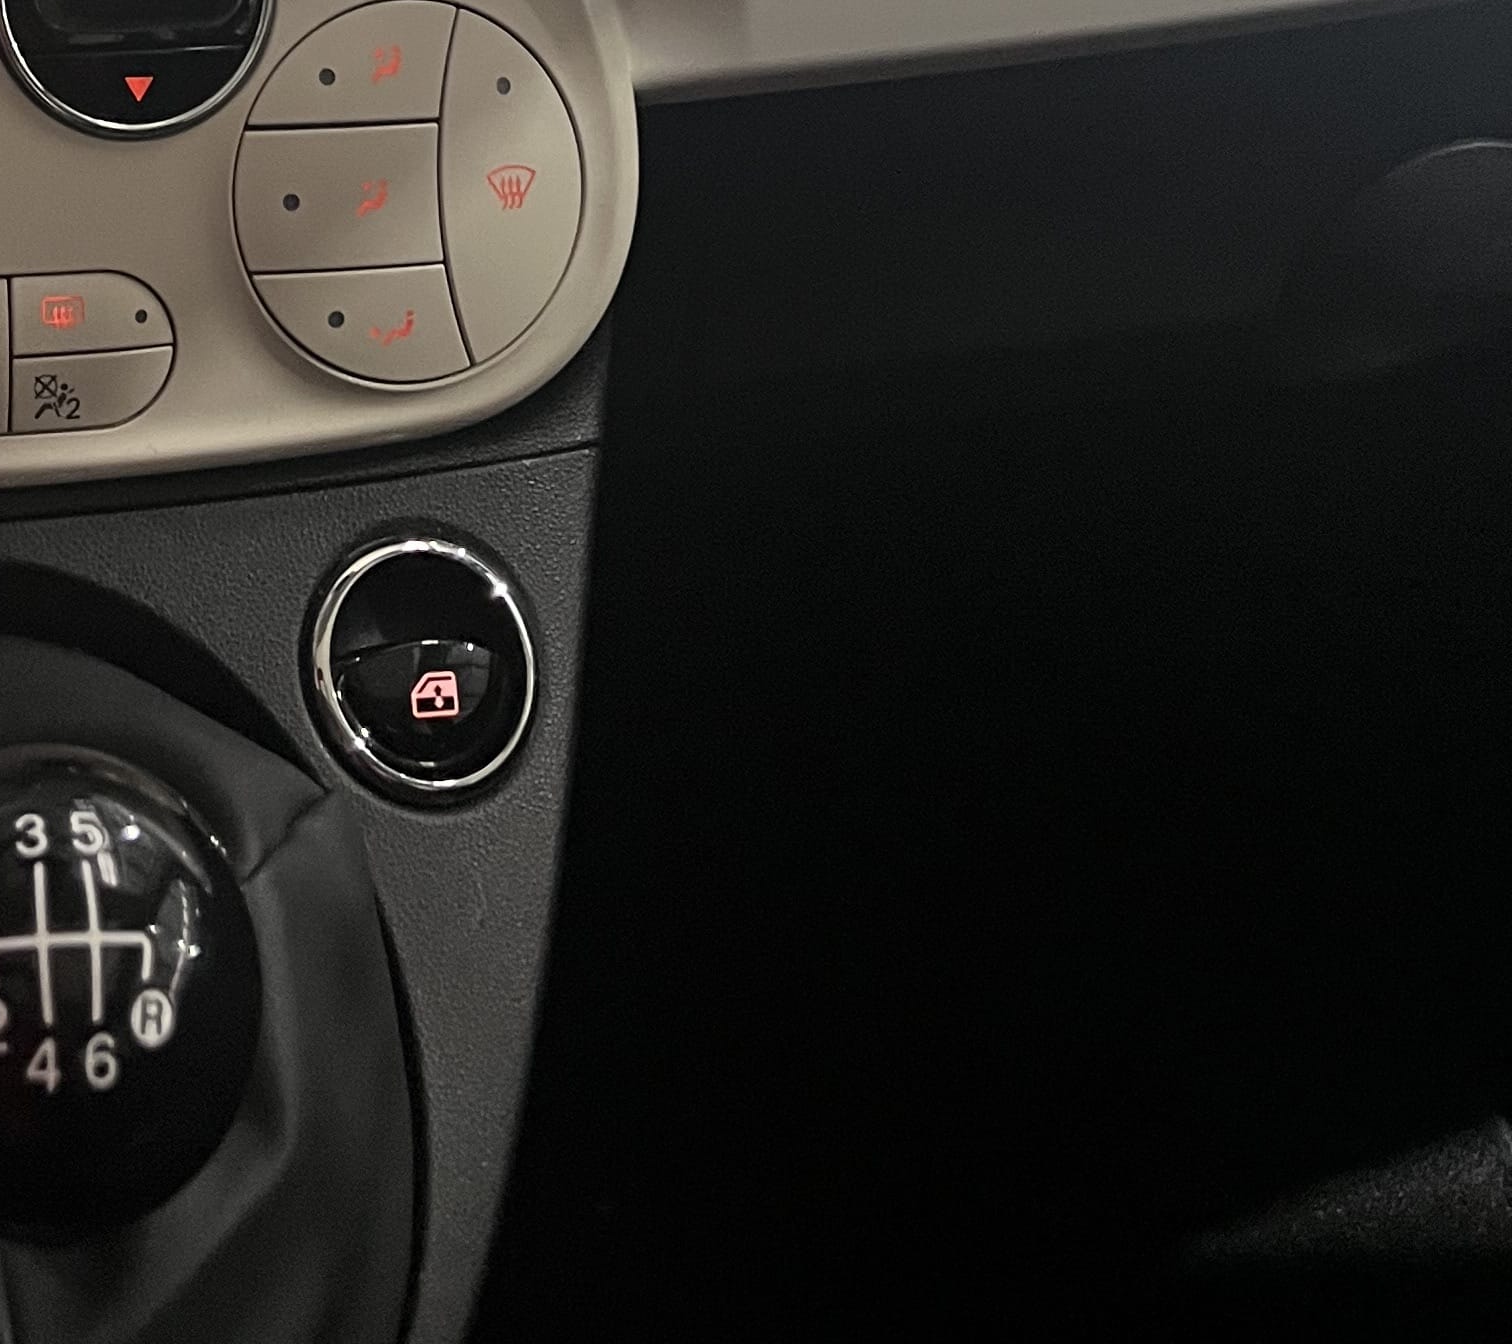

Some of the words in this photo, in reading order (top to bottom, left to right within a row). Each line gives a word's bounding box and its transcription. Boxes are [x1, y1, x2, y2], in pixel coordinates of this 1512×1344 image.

[66, 397, 80, 419] 2
[15, 814, 48, 859] 3
[70, 810, 105, 855] 5
[26, 1037, 61, 1093] 4
[85, 1032, 118, 1090] 6
